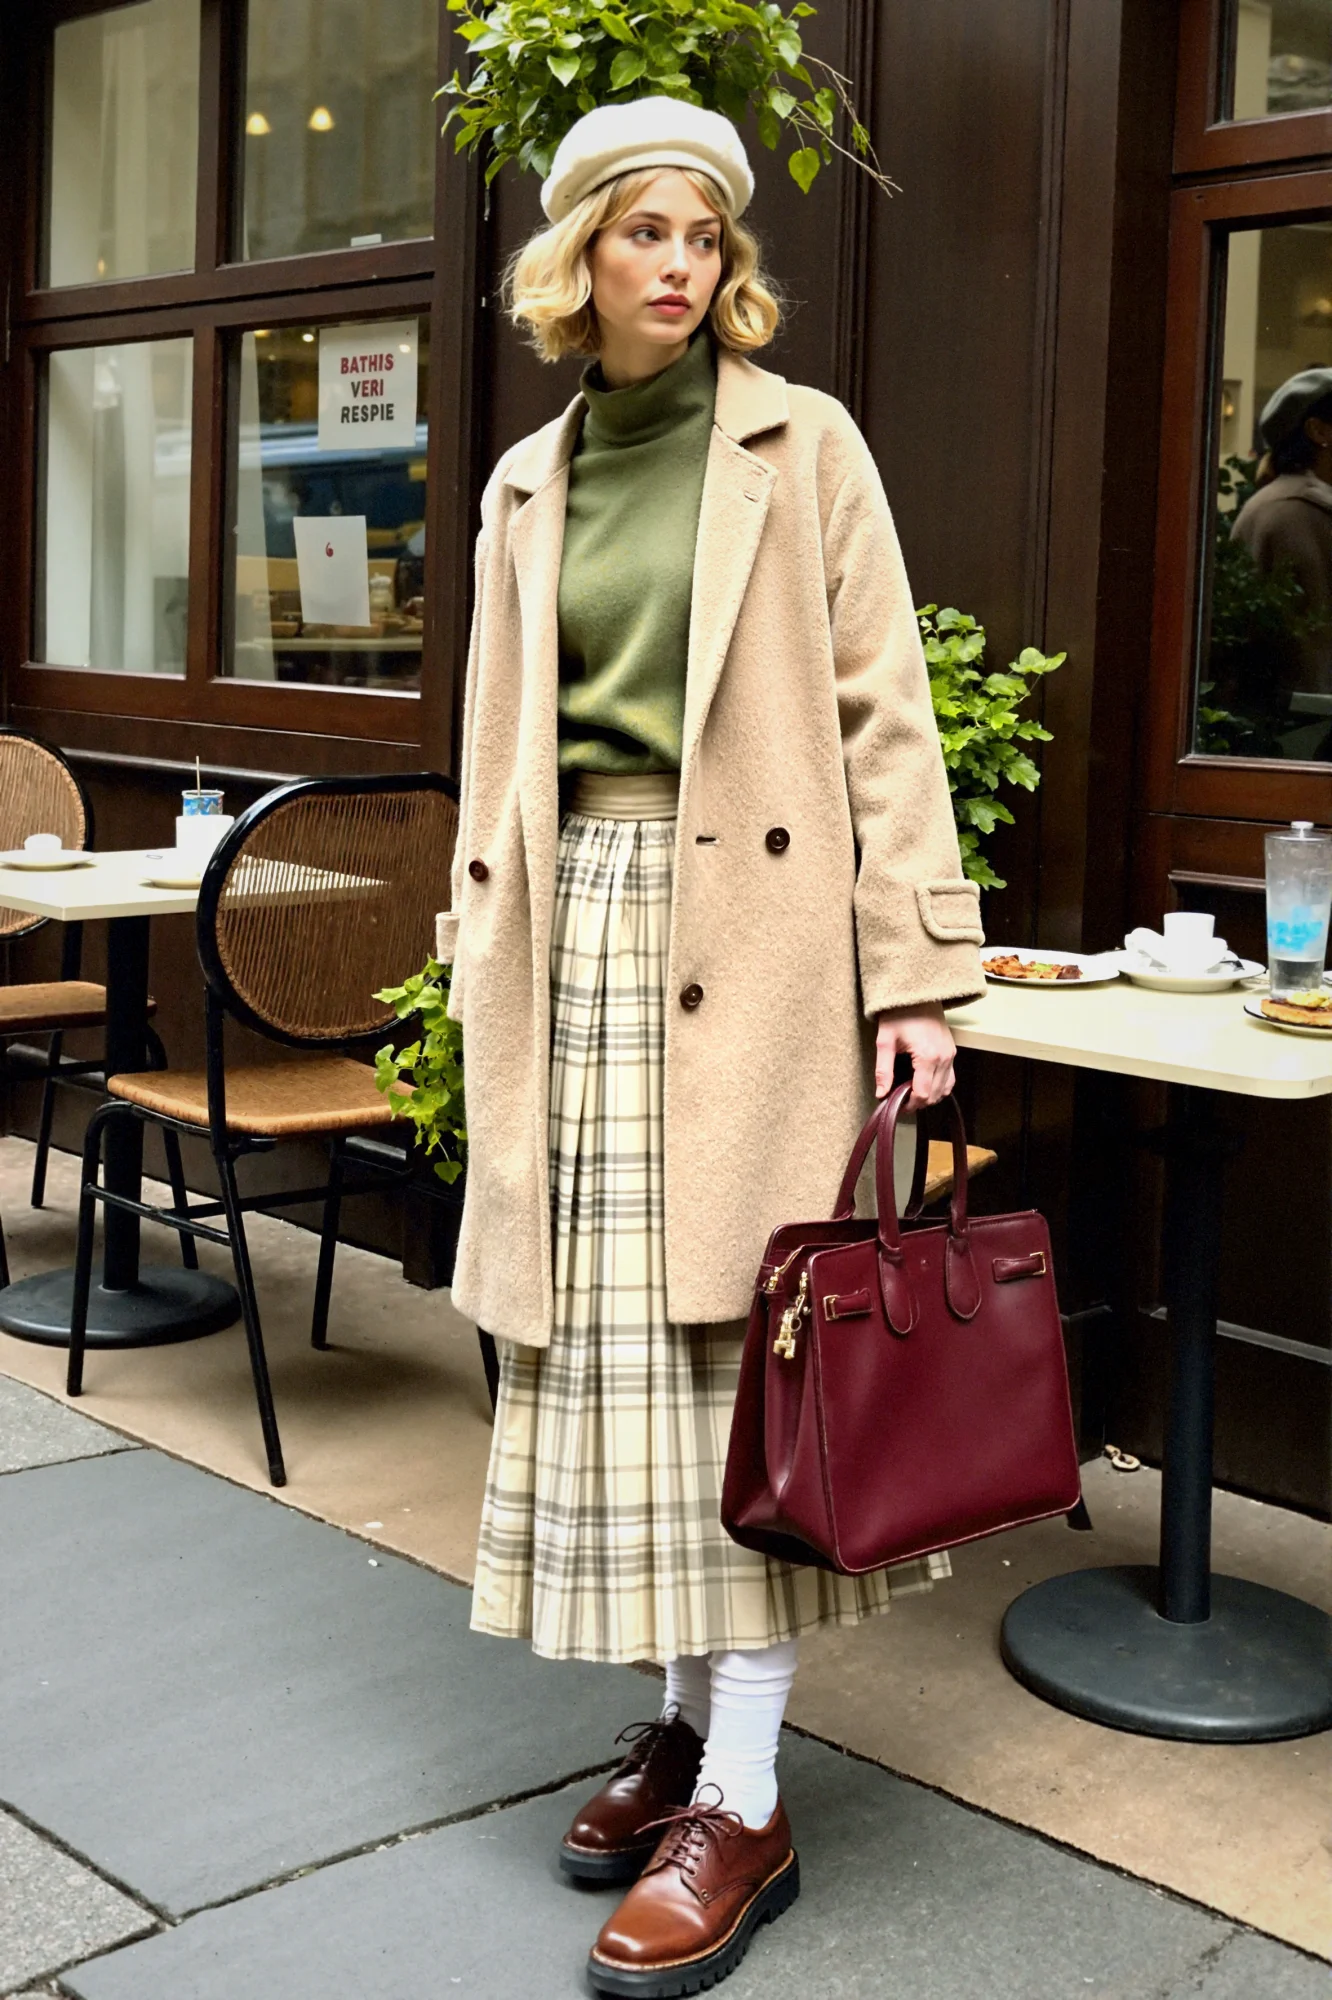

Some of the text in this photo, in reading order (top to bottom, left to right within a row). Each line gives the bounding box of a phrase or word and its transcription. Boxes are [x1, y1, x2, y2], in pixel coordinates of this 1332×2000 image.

[340, 353, 394, 374] BATHIS
[351, 379, 384, 398] VERI
[340, 403, 394, 424] RESPIE
